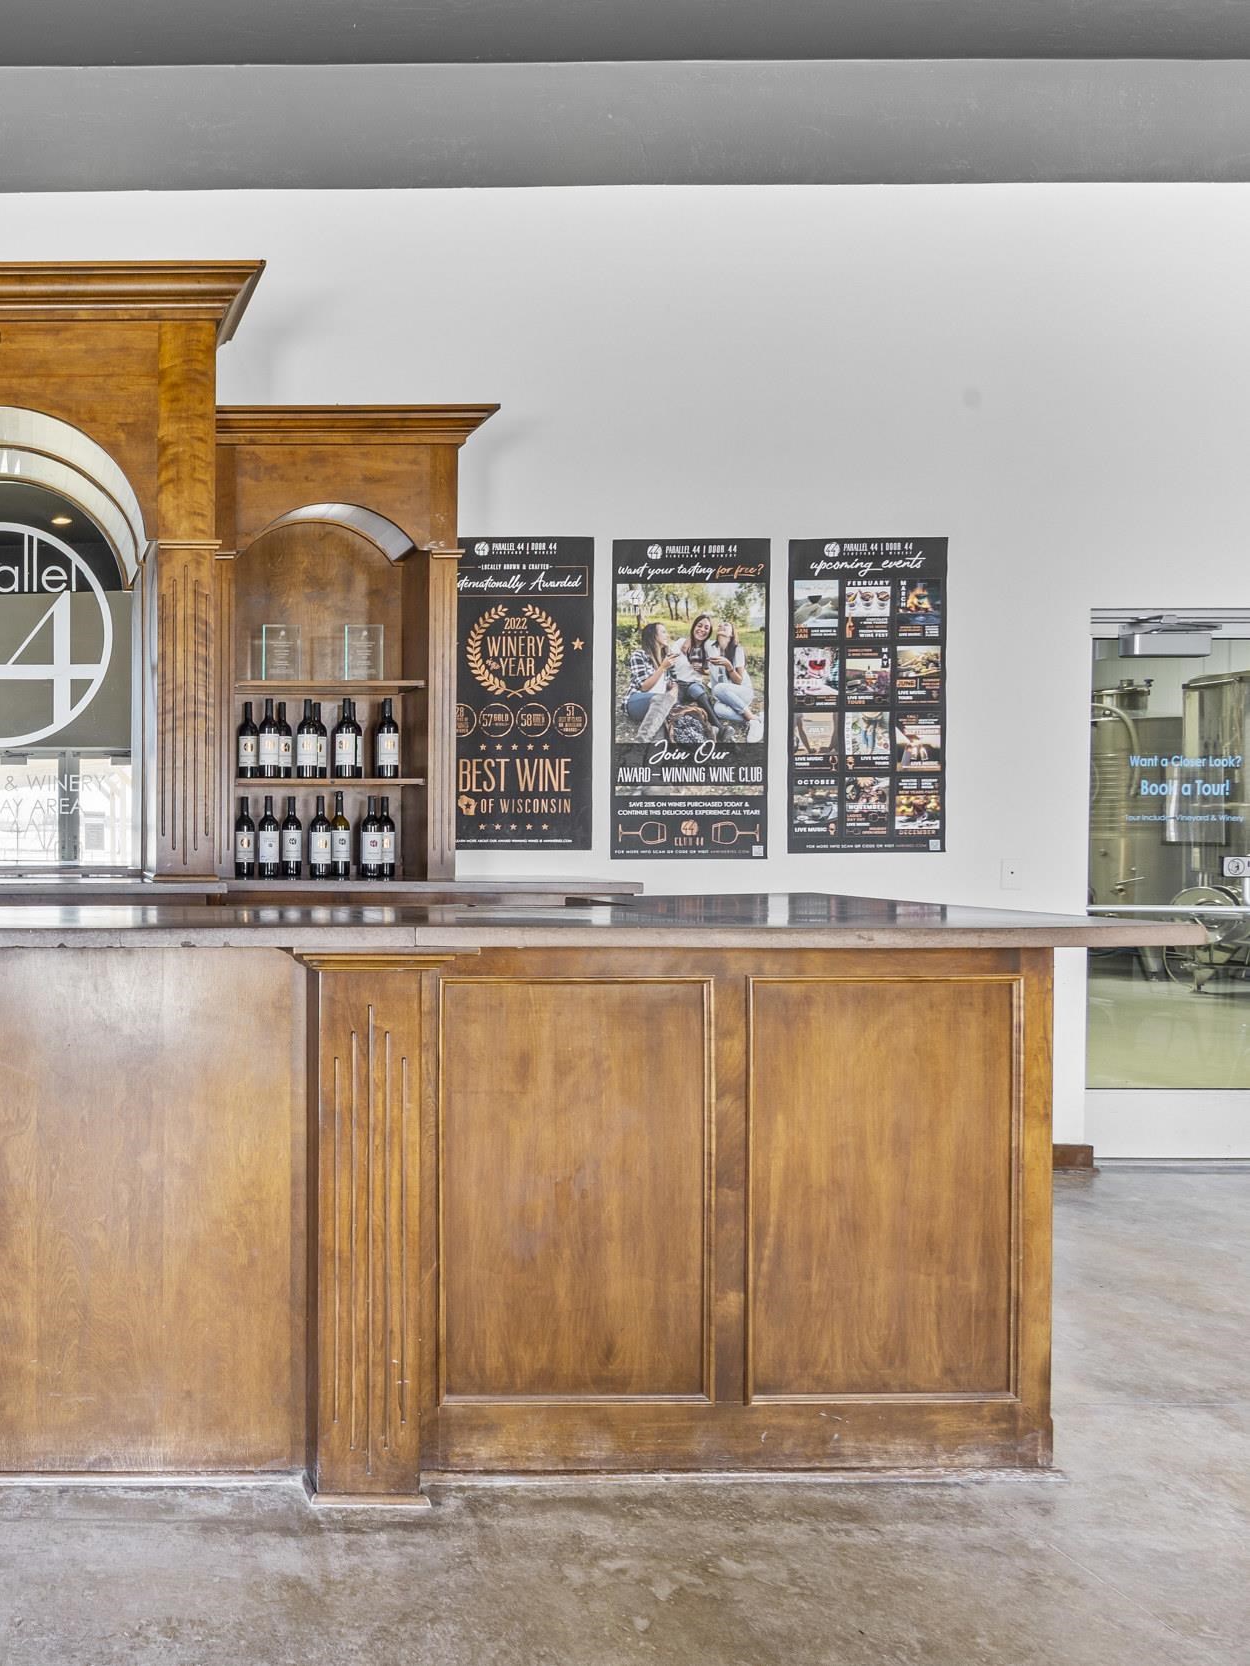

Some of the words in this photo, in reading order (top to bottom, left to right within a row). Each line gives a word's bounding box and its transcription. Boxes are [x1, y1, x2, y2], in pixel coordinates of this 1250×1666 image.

[492, 542, 515, 551] PARALLEL
[516, 542, 525, 551] 44
[548, 542, 557, 551] 44
[665, 545, 690, 554] PARALLEL
[692, 545, 700, 554] 44
[727, 544, 737, 553] 44
[843, 543, 868, 552] PARALLEL
[870, 543, 878, 551] 44
[904, 542, 913, 550] 44
[481, 563, 502, 571] LOCALLY
[617, 562, 649, 578] Want
[646, 566, 676, 581] your
[677, 561, 716, 581] tasting
[715, 564, 731, 579] for
[809, 558, 883, 577] upcoming
[881, 551, 927, 569] events
[529, 571, 583, 591] Awarded
[504, 617, 528, 630] 2022
[487, 635, 545, 657] WINERY
[500, 657, 536, 677] YEAR
[482, 713, 493, 727] 57
[493, 713, 509, 722] GOLD
[520, 713, 533, 727] 58
[648, 739, 691, 765] Join
[693, 739, 730, 764] Our
[1129, 755, 1158, 767] Want
[1160, 759, 1168, 767] a
[1171, 755, 1207, 767] Closer
[1209, 755, 1242, 767] Look?
[4, 774, 17, 792] &
[27, 774, 107, 792] WINERY
[458, 758, 510, 792] BEST
[515, 758, 572, 792] WINE
[709, 766, 736, 783] WINE
[738, 766, 763, 783] CLUB
[1181, 783, 1191, 796] a
[1195, 779, 1230, 796] Tour!
[32, 797, 85, 815] AREA
[480, 798, 495, 813] OF
[500, 798, 571, 814] WISCONSIN
